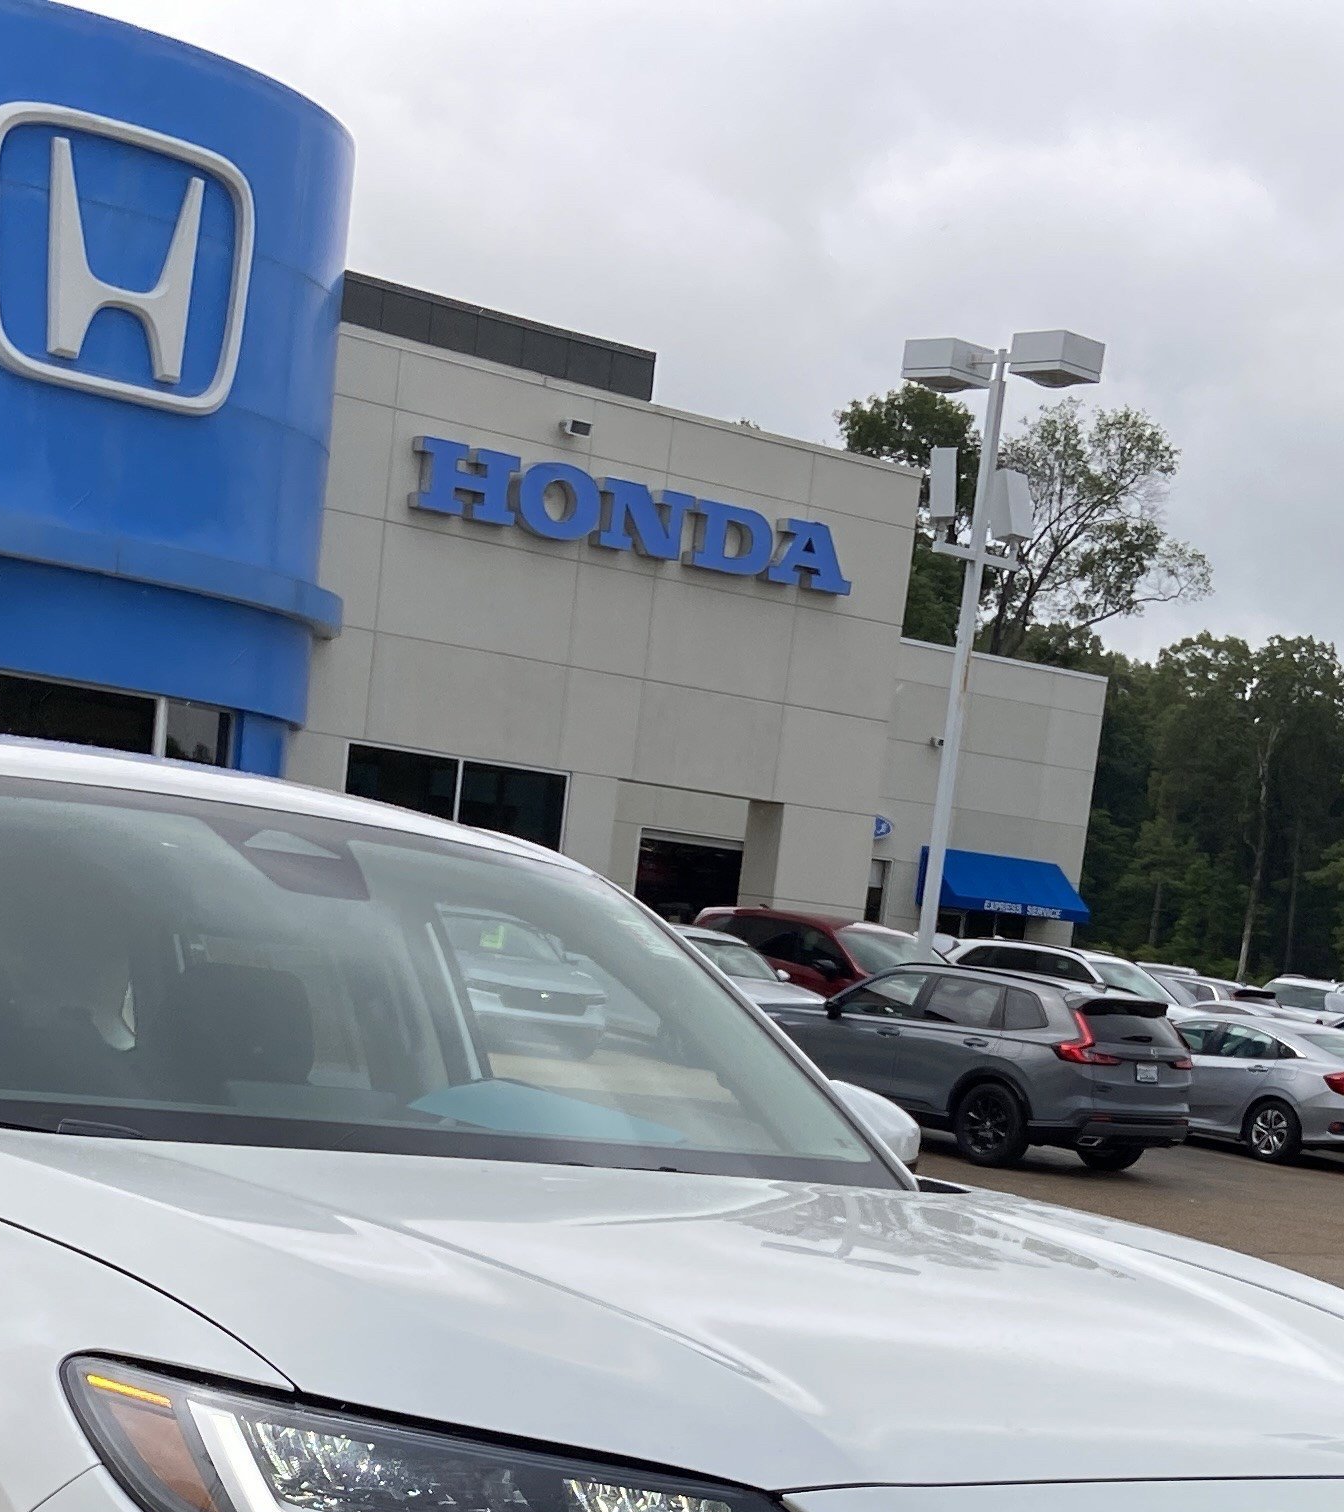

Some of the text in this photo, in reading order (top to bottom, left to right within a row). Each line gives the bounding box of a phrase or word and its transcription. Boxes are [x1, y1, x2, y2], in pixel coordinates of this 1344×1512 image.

[407, 435, 852, 596] HONDA
[984, 900, 1063, 919] EXPRESS SERVICE
